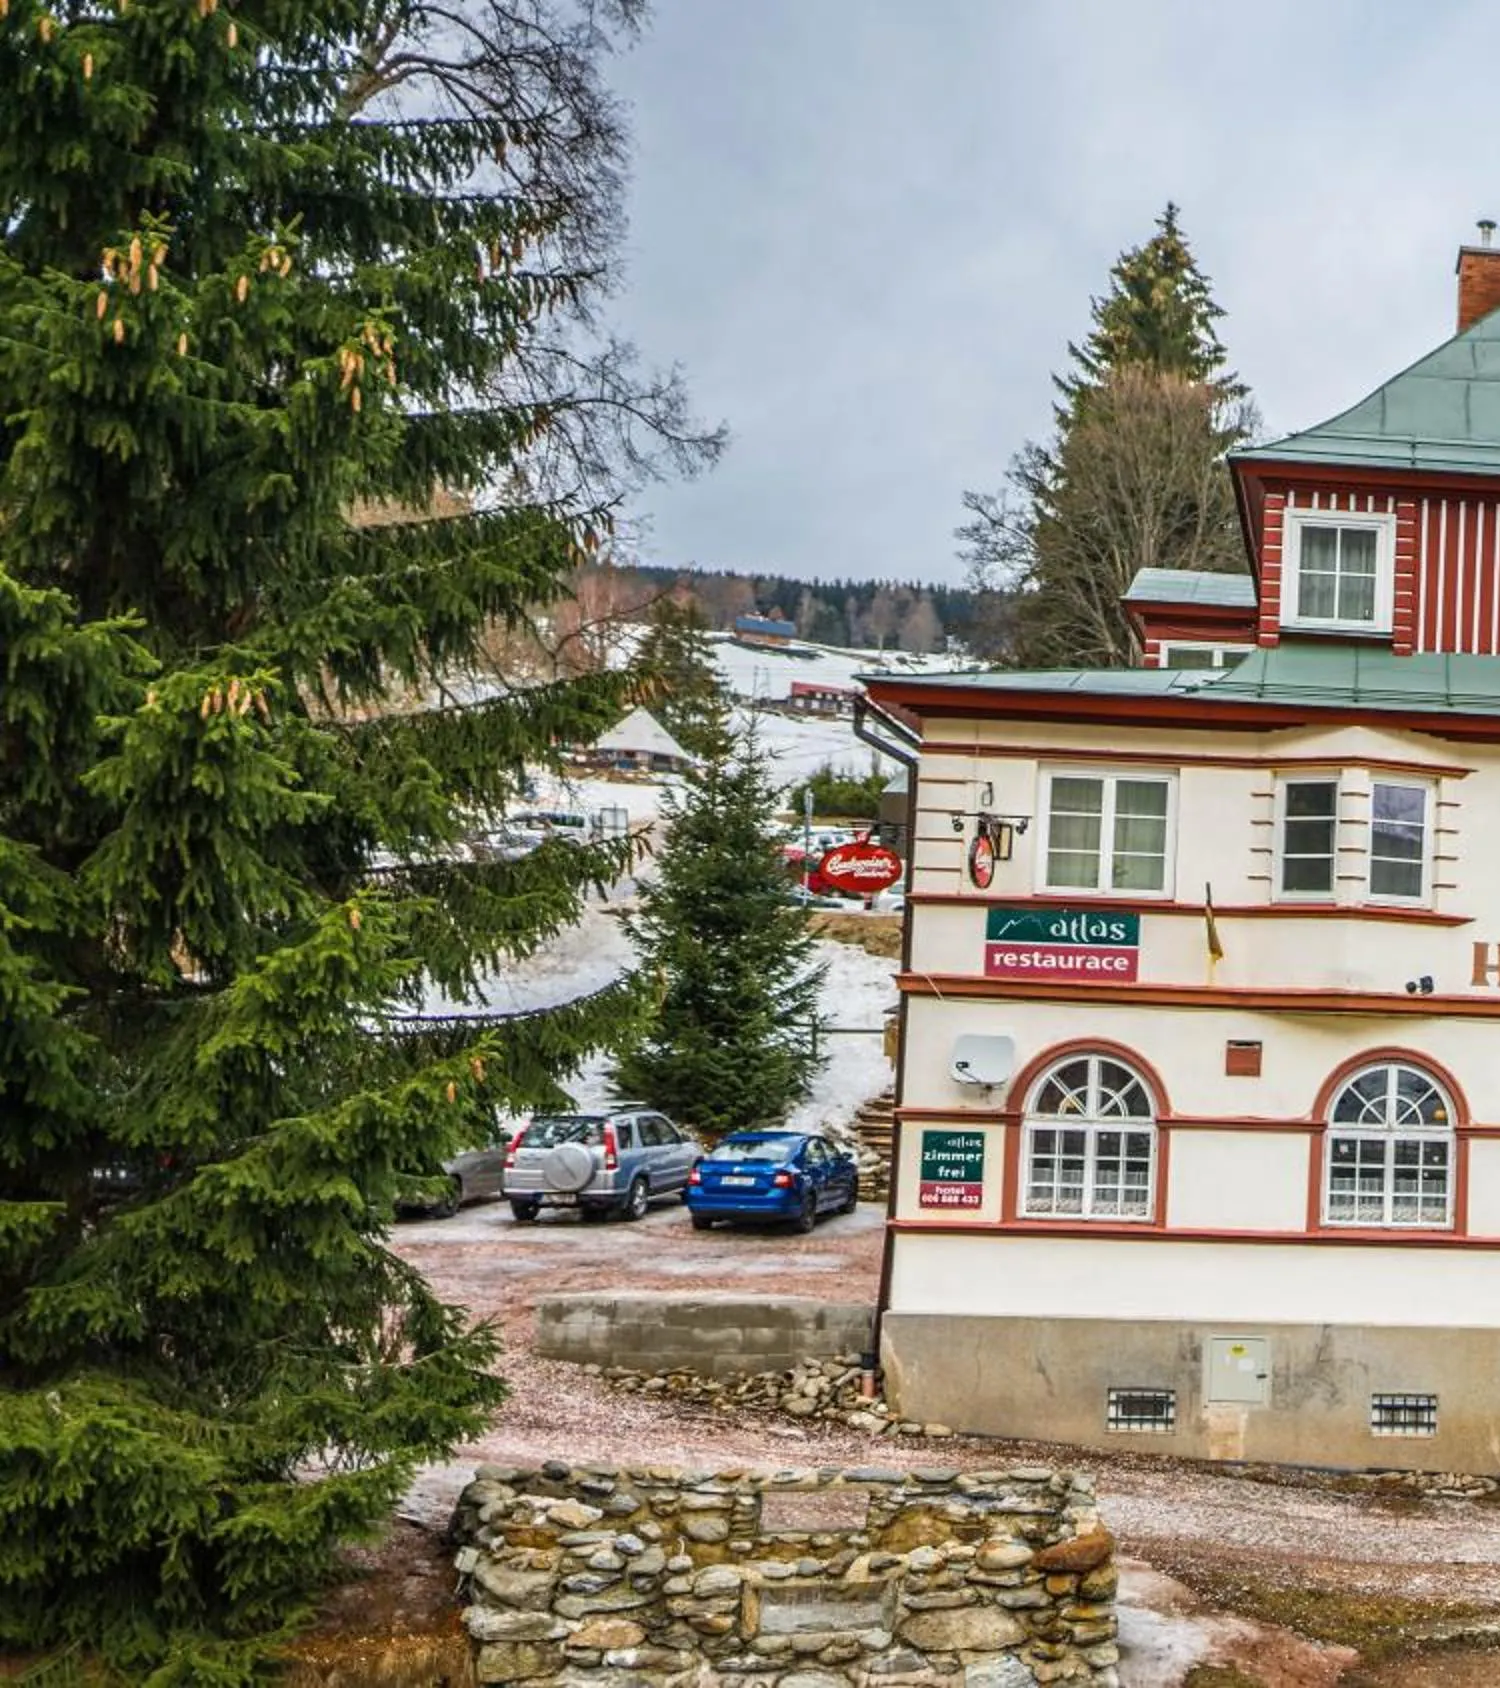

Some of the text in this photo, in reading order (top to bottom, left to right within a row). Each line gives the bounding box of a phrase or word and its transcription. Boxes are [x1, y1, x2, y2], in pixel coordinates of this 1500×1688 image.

[1050, 914, 1126, 942] atlas
[993, 951, 1129, 971] restaurace
[923, 1149, 982, 1162] zimmer
[938, 1166, 965, 1177] frei
[935, 1186, 965, 1195] hotel
